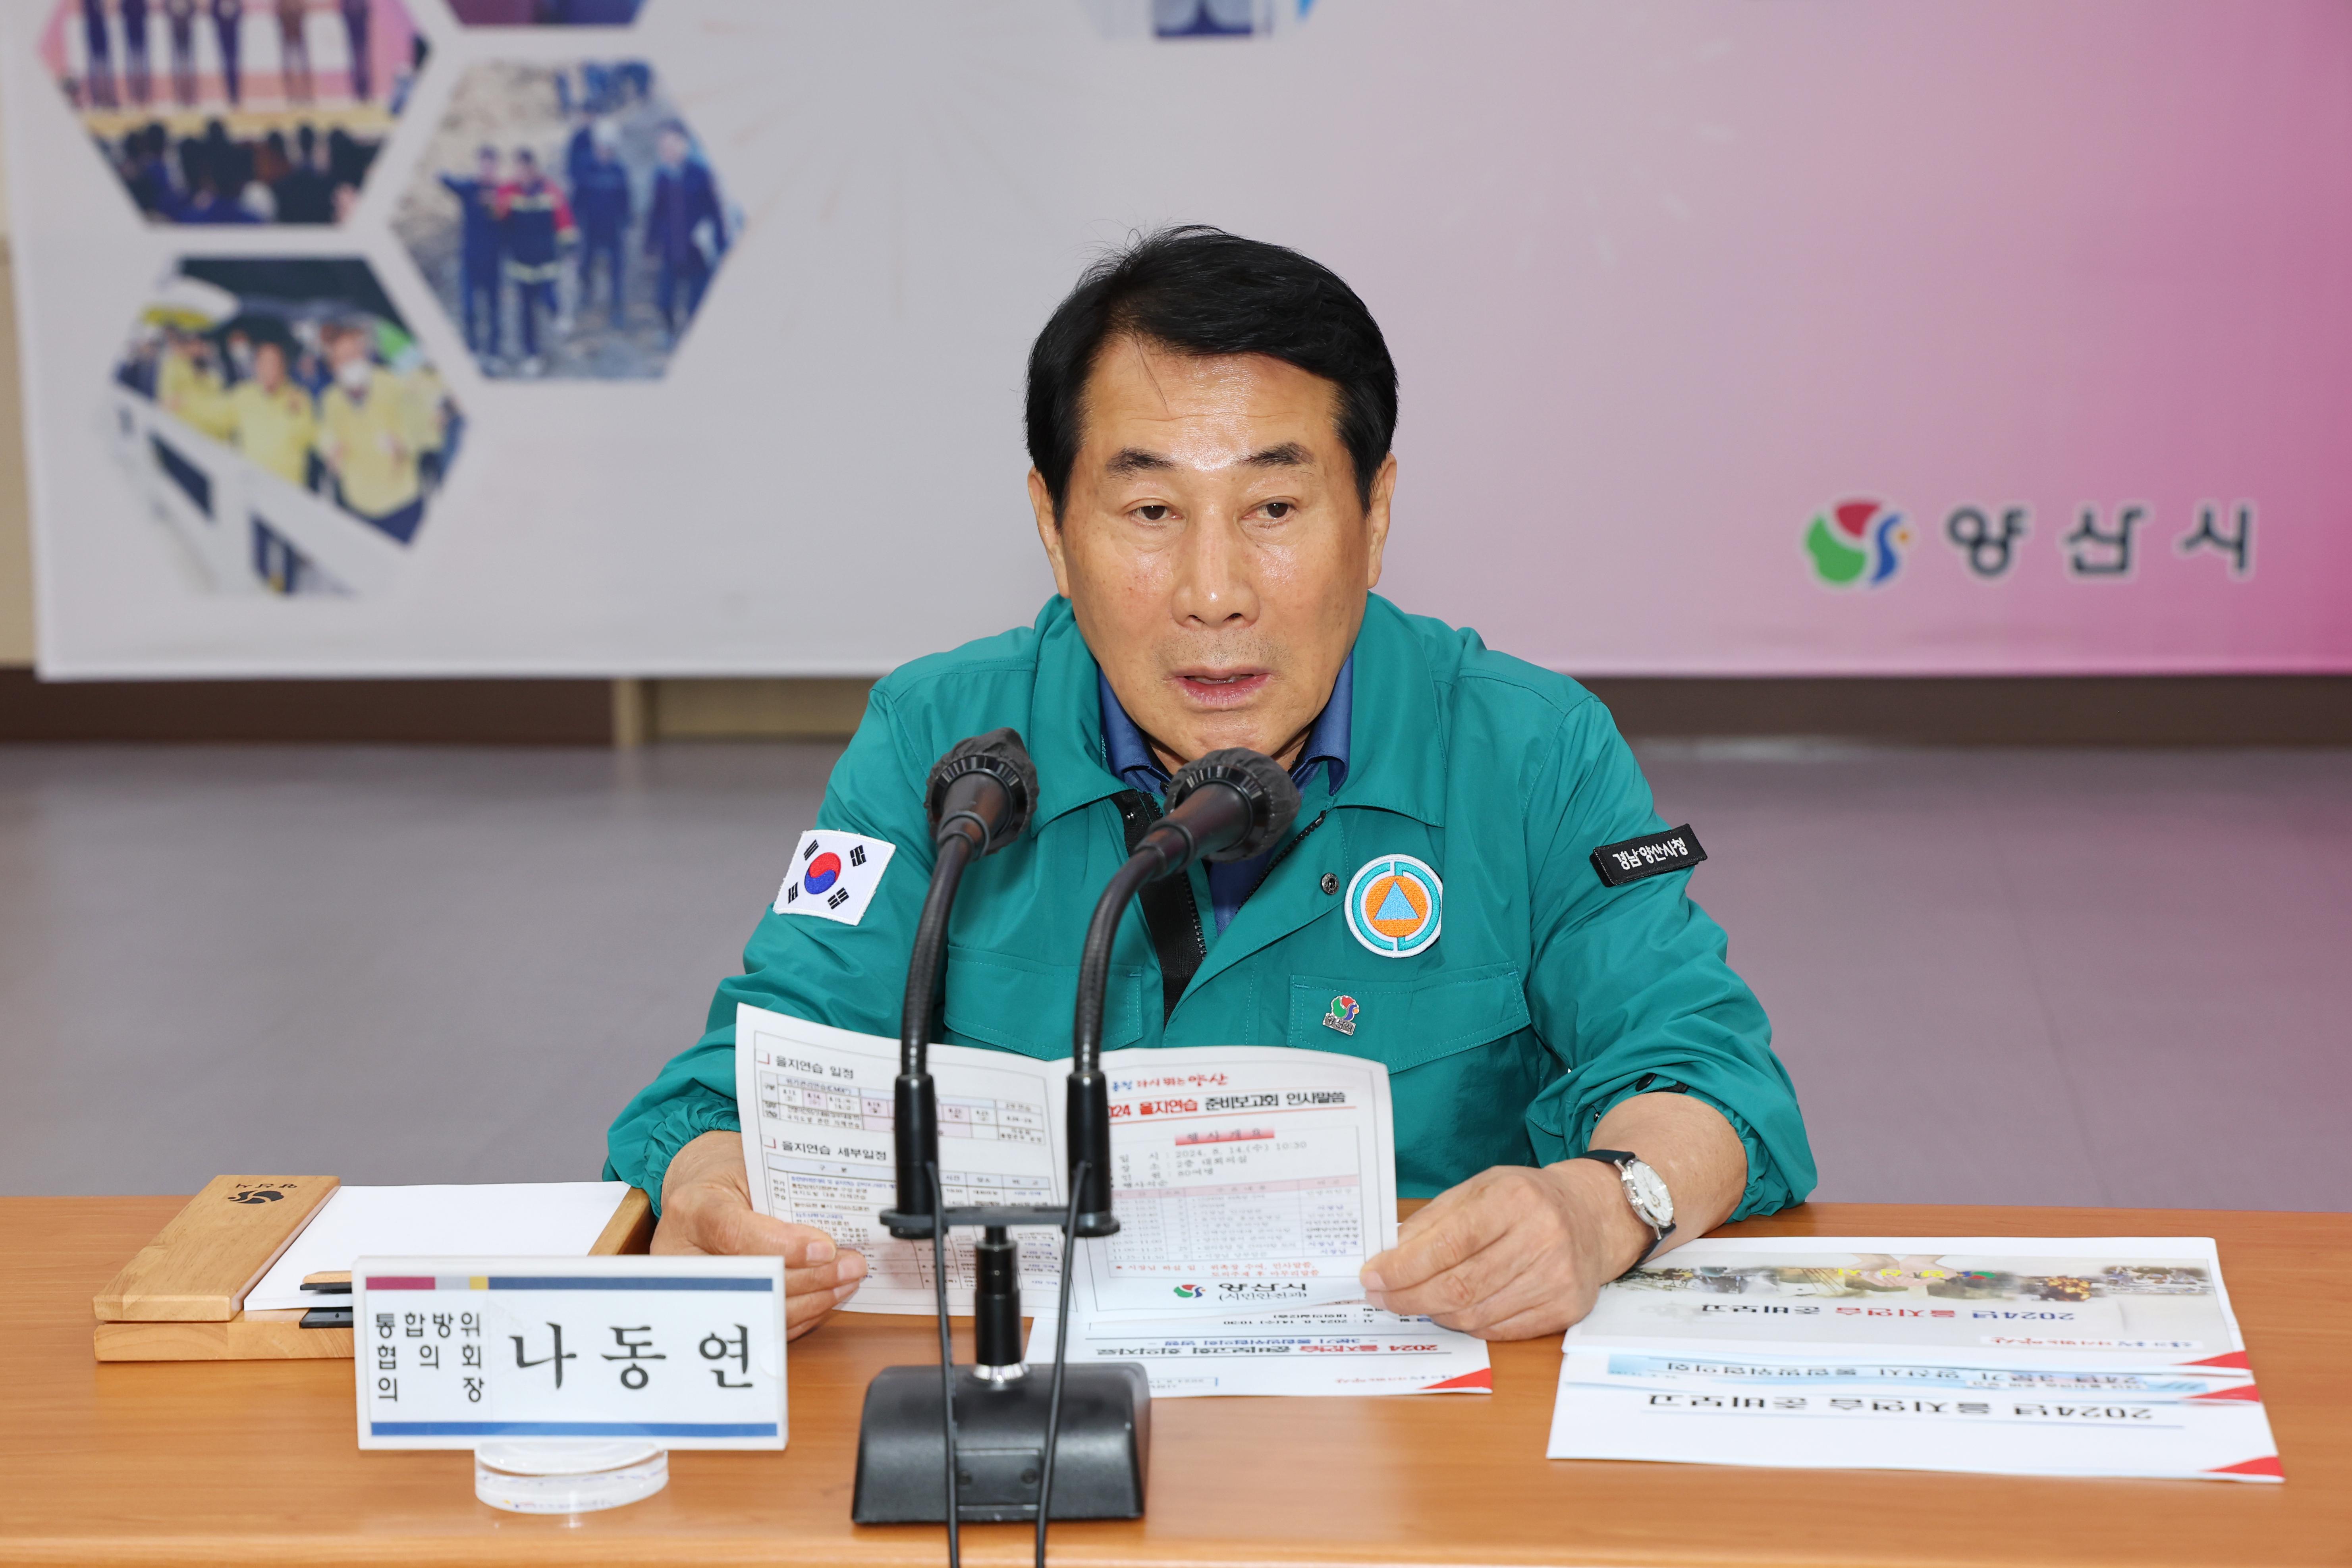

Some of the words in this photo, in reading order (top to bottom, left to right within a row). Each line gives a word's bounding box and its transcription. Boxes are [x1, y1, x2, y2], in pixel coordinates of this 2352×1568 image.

[1947, 505, 2249, 576] 양산시
[1327, 1015, 1353, 1033] 양산시
[776, 1055, 823, 1074] 을지연습
[830, 1066, 854, 1079] 일정
[1188, 1072, 1228, 1087] 양산
[1139, 1099, 1198, 1115] 을지연습
[1206, 1093, 1279, 1111] 준비보고회
[1287, 1090, 1346, 1106] 인사말씀
[782, 1140, 831, 1155] 을지연습
[837, 1147, 886, 1161] 세부일정
[1218, 1283, 1307, 1292] 양산시
[1219, 1292, 1307, 1301] (시민안전과)
[1701, 1304, 1821, 1315] 준비보고
[1835, 1307, 1956, 1318] 을지연습
[1972, 1310, 2076, 1320] 2024년
[376, 1312, 481, 1338] 통합방위
[509, 1321, 753, 1391] 나동연
[1096, 1347, 1182, 1355] 회의자료
[1192, 1345, 1290, 1354] 준비보고회
[1300, 1344, 1378, 1353] 을지연습
[377, 1345, 482, 1370] 협의회
[1667, 1362, 1857, 1377] 통합방위협의회
[1879, 1368, 1959, 1379] 양산시
[1648, 1394, 1808, 1410] 준비보고
[1829, 1398, 1991, 1414] 을지연습
[2014, 1402, 2153, 1419] 2024년
